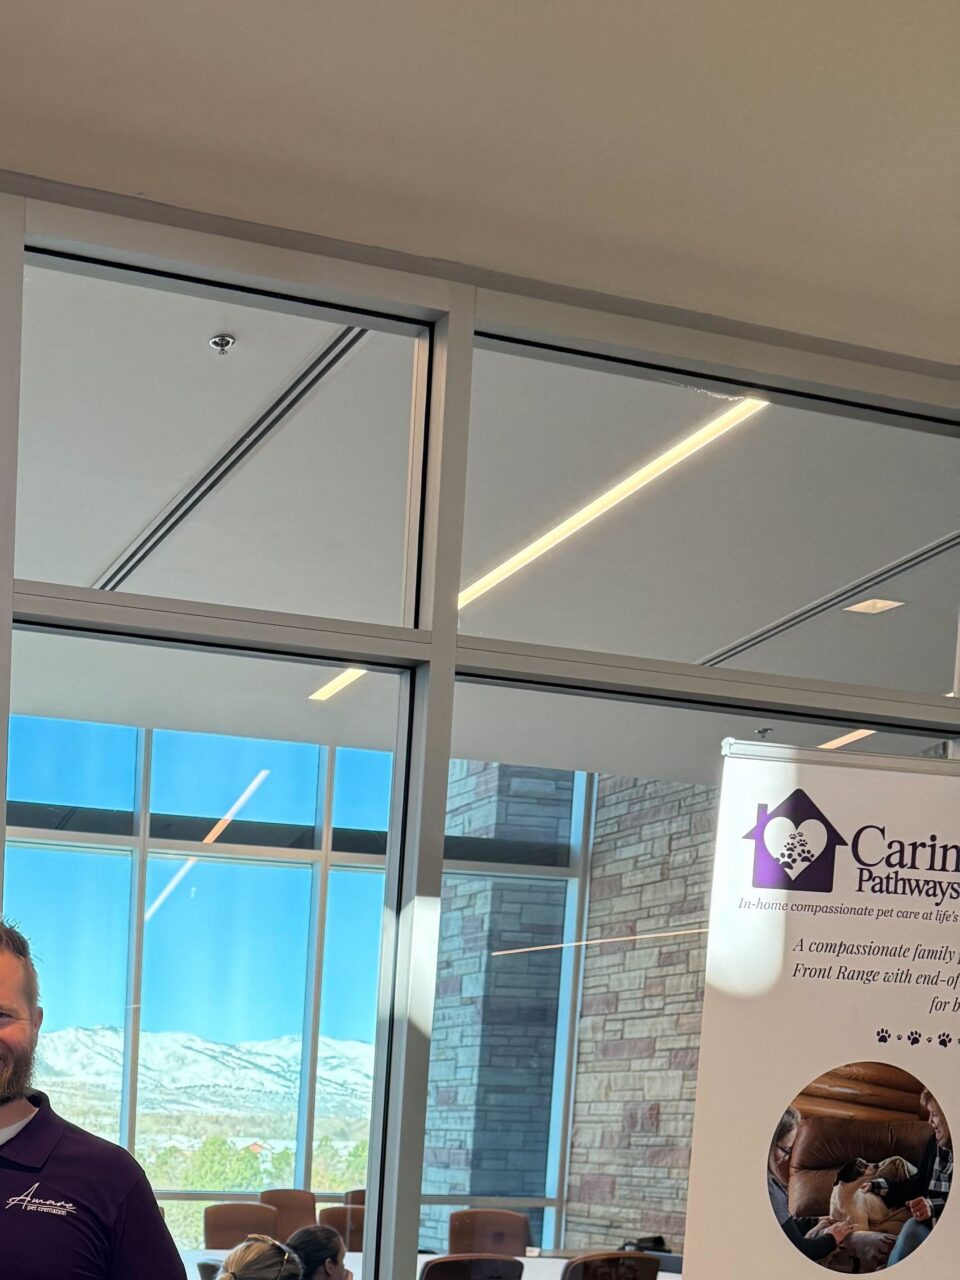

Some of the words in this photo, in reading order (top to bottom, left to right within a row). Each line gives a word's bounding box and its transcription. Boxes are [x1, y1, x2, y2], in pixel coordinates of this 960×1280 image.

[855, 867, 960, 907] Pathways
[738, 897, 788, 911] In-home
[790, 903, 874, 918] compassionate
[875, 907, 894, 920] pet
[896, 909, 920, 919] care
[922, 910, 933, 921] at
[935, 909, 959, 924] life's
[792, 937, 804, 952] A
[808, 940, 910, 958] compassionate
[912, 943, 955, 964] family
[792, 963, 833, 980] Front
[836, 965, 880, 985] Range
[883, 967, 912, 984] with
[929, 996, 950, 1014] for
[5, 1182, 76, 1209] Amare
